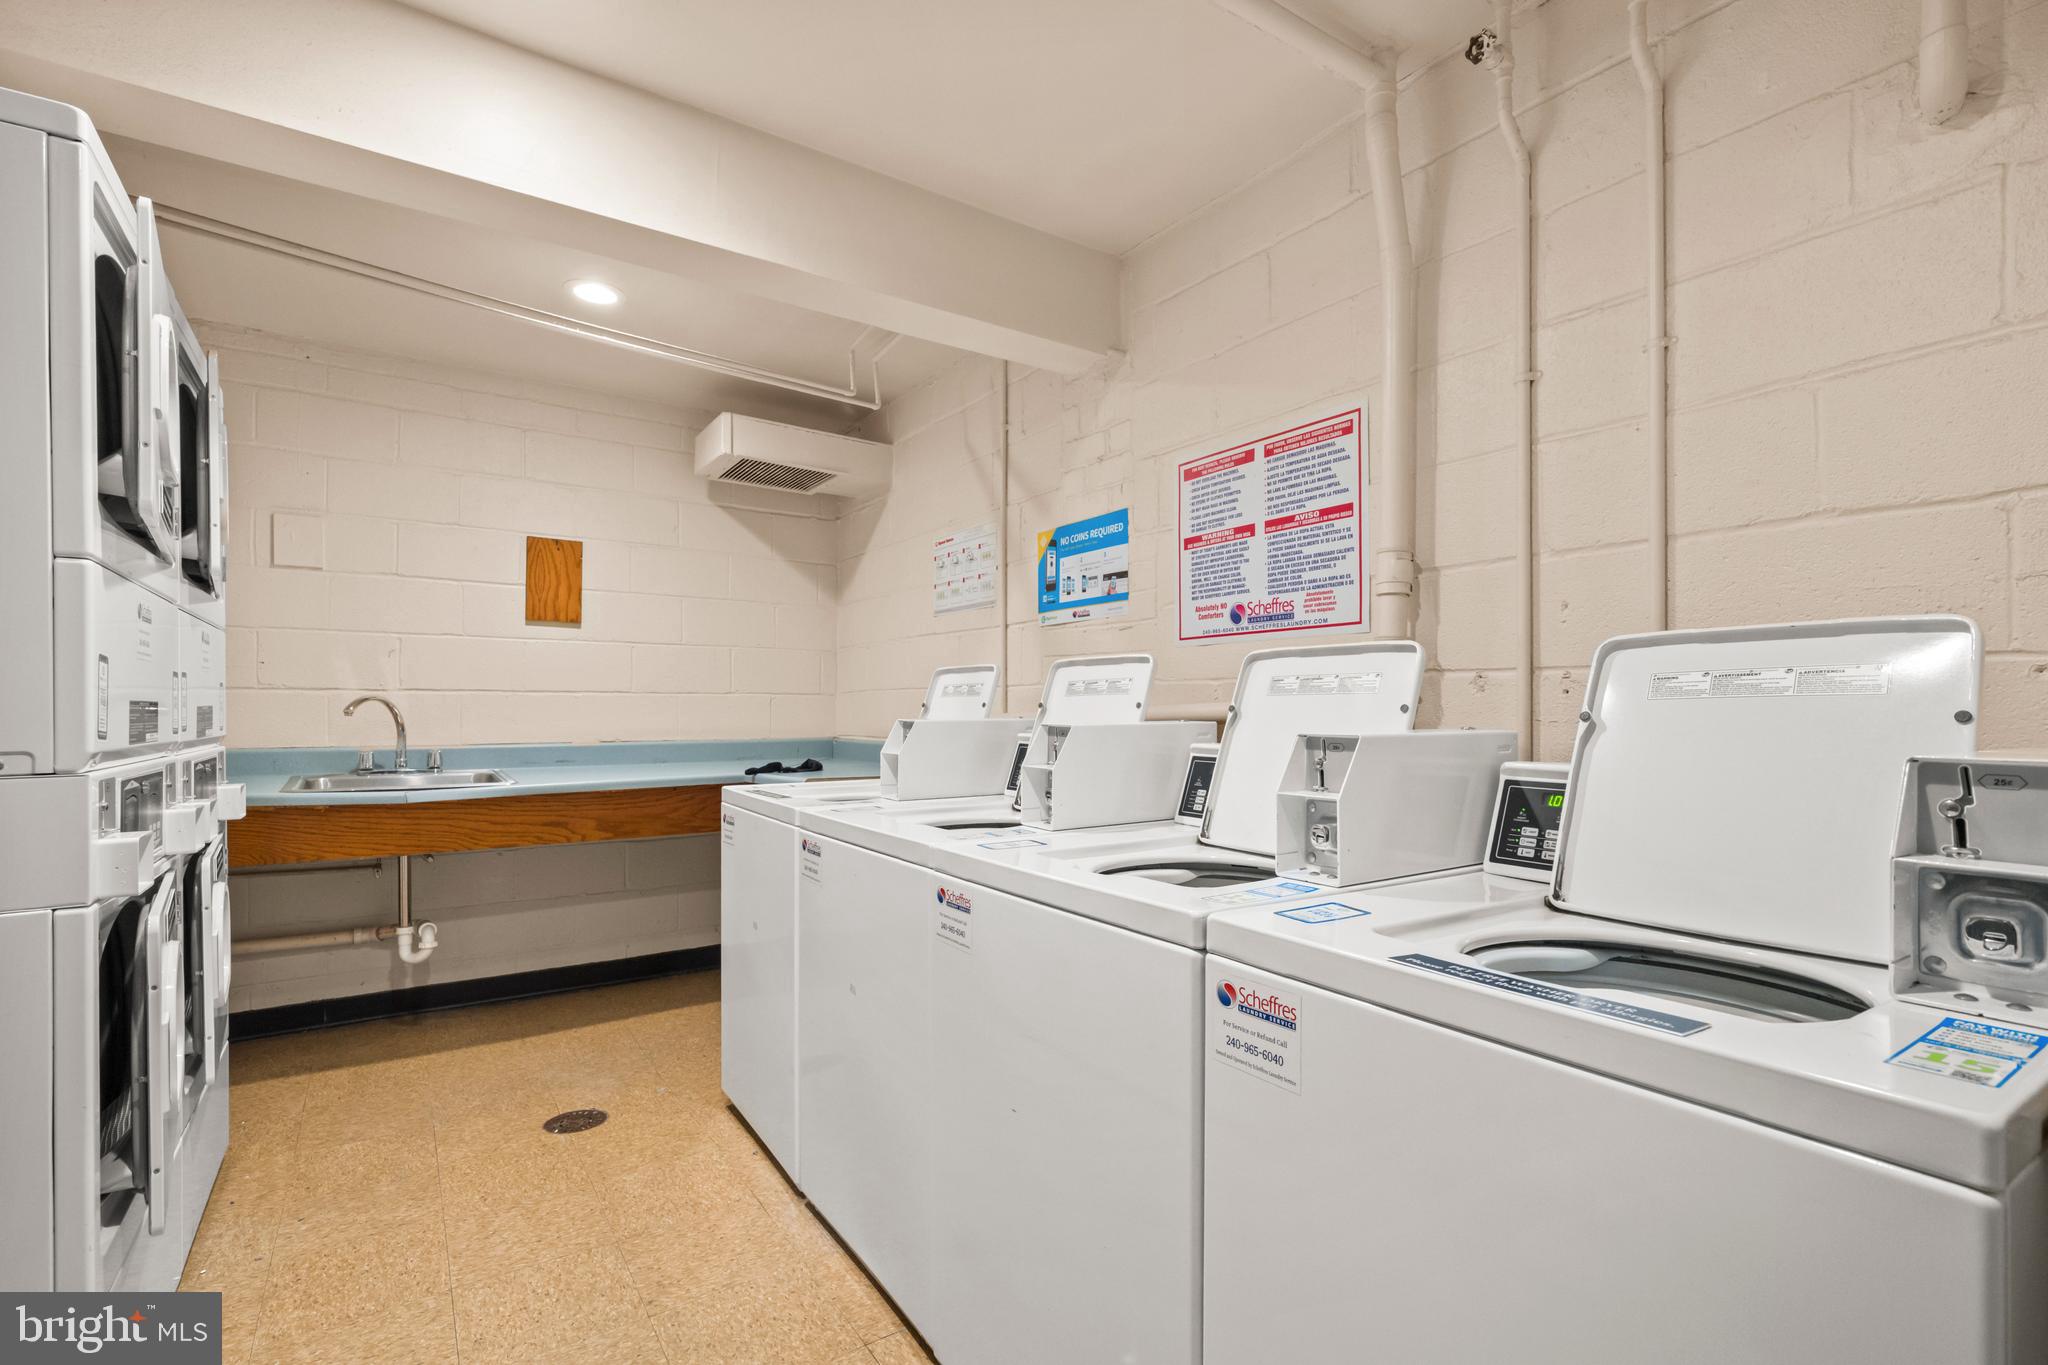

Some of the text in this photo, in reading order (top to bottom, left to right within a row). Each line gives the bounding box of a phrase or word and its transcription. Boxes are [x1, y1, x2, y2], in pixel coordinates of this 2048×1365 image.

[1294, 510, 1320, 522] AVISO
[1060, 522, 1124, 546] NO COINS REQUIRED
[1201, 529, 1234, 541] WARNING
[1195, 602, 1228, 613] Absolutely NO
[1198, 611, 1224, 620] Comforters
[1247, 595, 1295, 616] Scheffres
[1236, 617, 1328, 632] WWW.SCHEFFRESLAUNDRY.COM
[946, 888, 972, 908] Scheffres
[1405, 958, 1444, 970] Please
[1445, 968, 1494, 983] respect
[1495, 981, 1533, 992] those
[1536, 991, 1569, 1002] with
[1238, 987, 1296, 1022] Scheffres
[1239, 1005, 1296, 1030] LAUNDRY SERVICE
[1223, 1020, 1232, 1028] For
[1232, 1022, 1249, 1034] Service
[1257, 1032, 1275, 1044] Refund
[1277, 1040, 1287, 1048] Call
[1226, 1035, 1284, 1066] 240-965-6040
